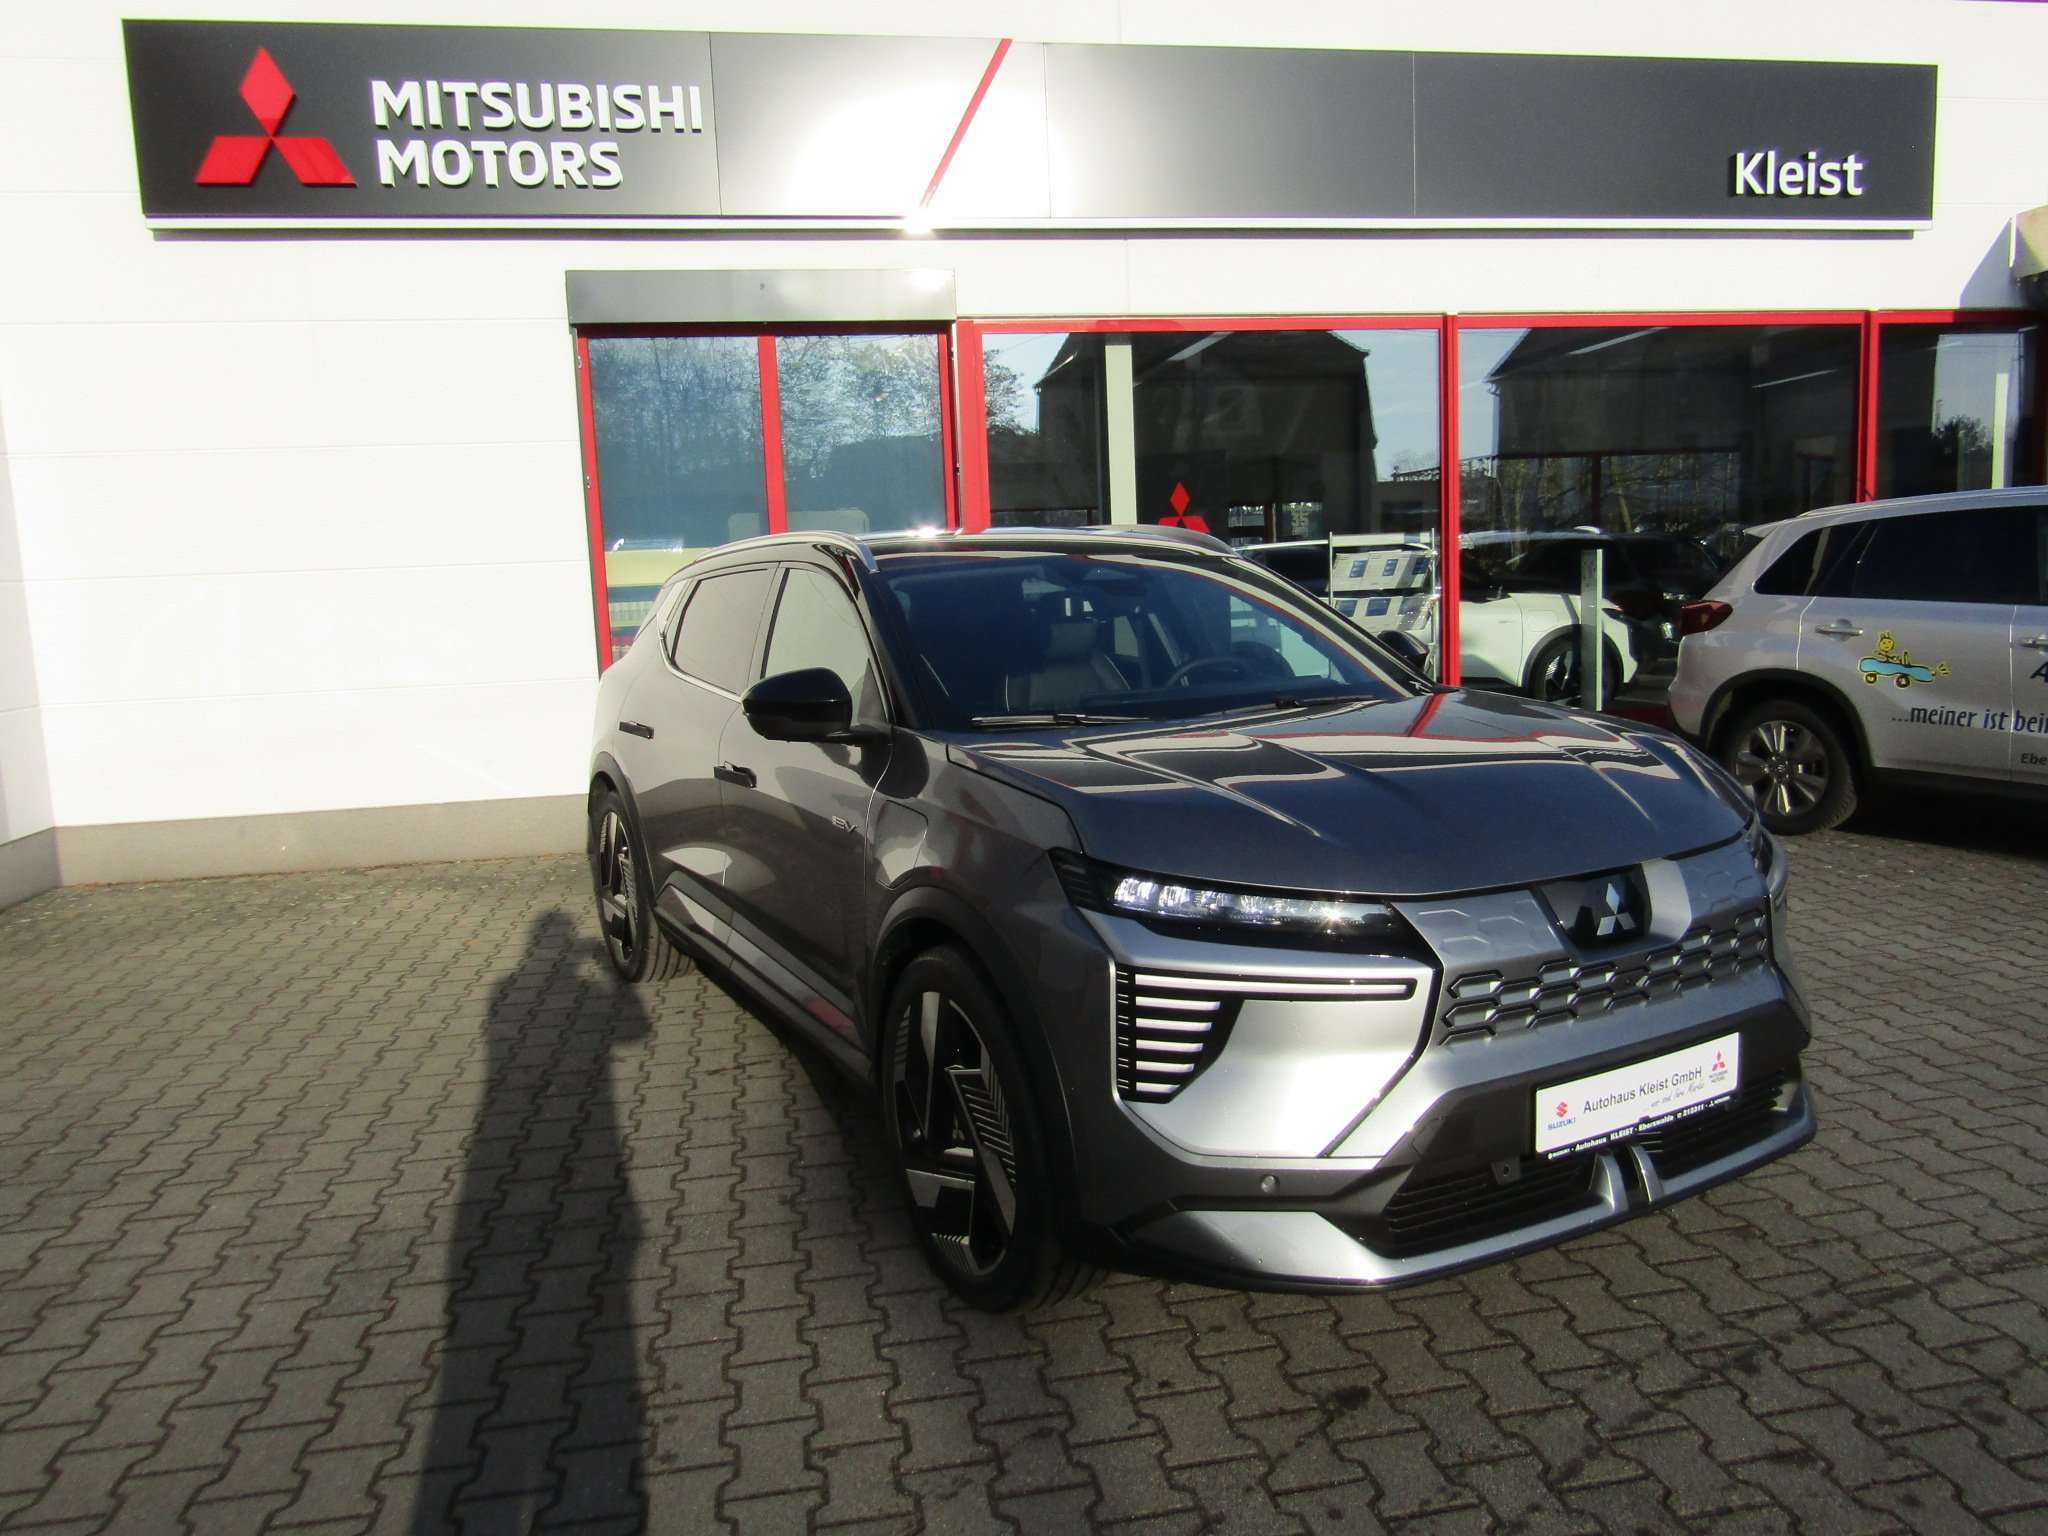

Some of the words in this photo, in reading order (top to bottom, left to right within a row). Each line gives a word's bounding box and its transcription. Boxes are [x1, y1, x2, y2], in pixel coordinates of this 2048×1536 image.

[371, 80, 702, 133] MITSUBISHI
[376, 139, 624, 188] MOTORS
[1735, 150, 1864, 196] Kleist
[1983, 709, 2009, 730] ist
[1583, 1088, 1636, 1113] Autohaus
[1639, 1077, 1669, 1097] Kleist
[1671, 1065, 1702, 1087] GmbH
[1548, 1116, 1576, 1131] SUZUKI
[1575, 1137, 1607, 1151] Autohaus
[1610, 1127, 1634, 1141] KLEIST
